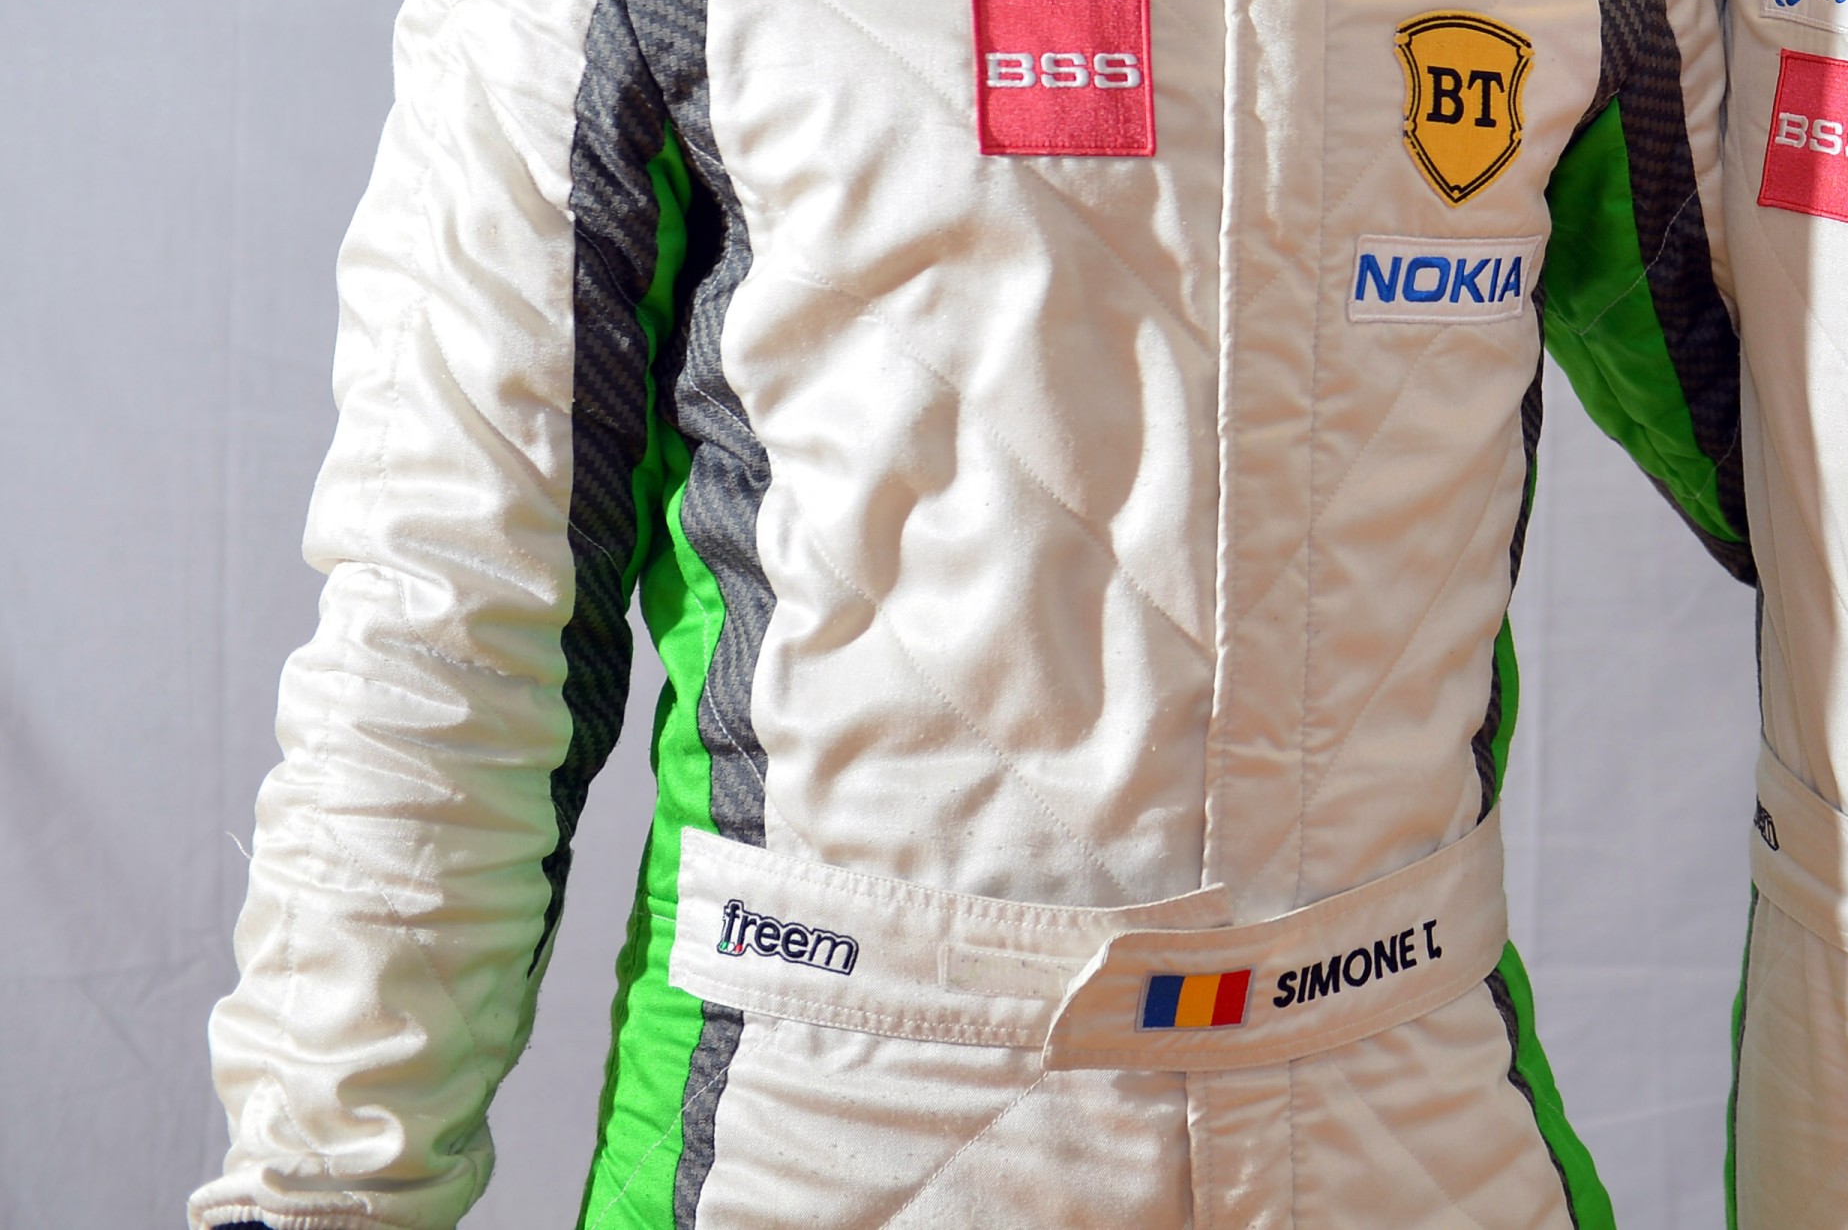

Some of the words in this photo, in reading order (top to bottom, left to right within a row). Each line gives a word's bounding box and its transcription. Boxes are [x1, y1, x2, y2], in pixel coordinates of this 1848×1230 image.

[986, 52, 1142, 91] BSS
[1426, 67, 1506, 128] BT
[1356, 252, 1523, 304] NOKIA
[716, 899, 859, 975] freem
[1273, 927, 1418, 1009] SIMONE
